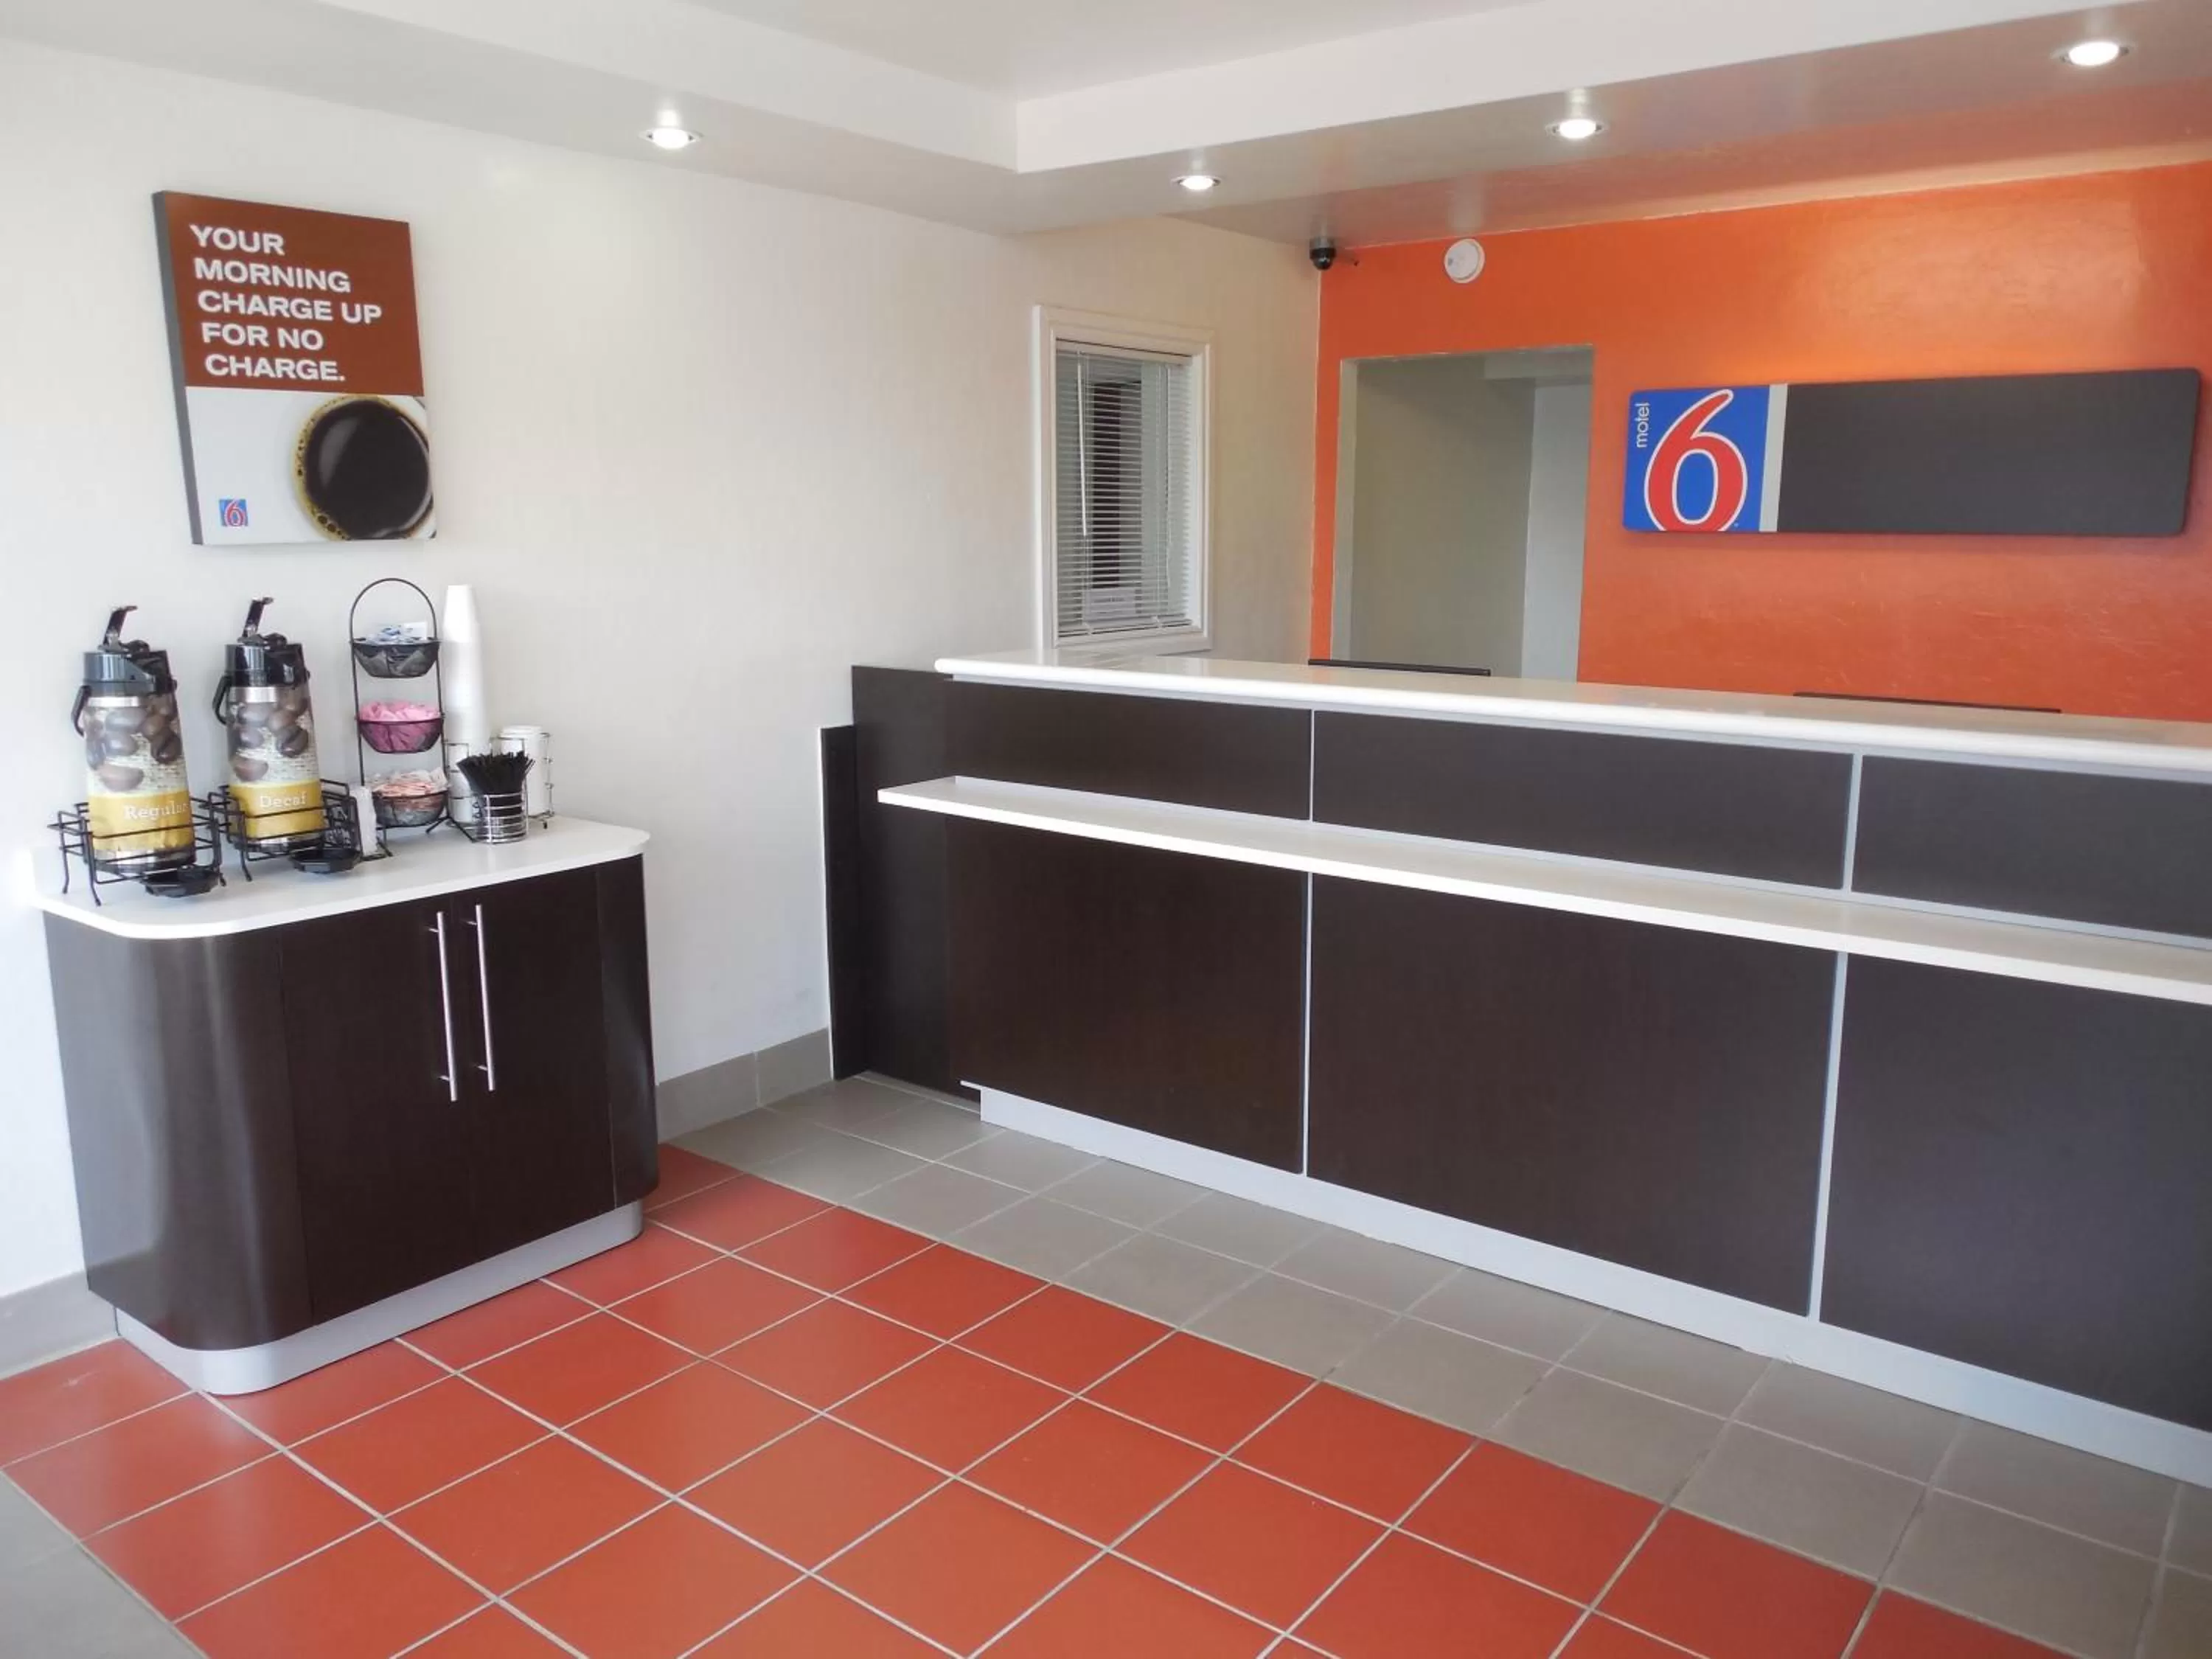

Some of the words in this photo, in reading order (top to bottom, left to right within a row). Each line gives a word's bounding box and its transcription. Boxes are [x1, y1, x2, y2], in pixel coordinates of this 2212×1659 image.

[189, 224, 285, 256] YOUR
[193, 257, 352, 293] MORNING
[198, 291, 333, 322] CHARGE
[341, 303, 382, 324] UP
[201, 322, 269, 347] FOR
[278, 329, 324, 351] NO
[204, 354, 345, 382] CHARGE.
[1635, 402, 1650, 448] motel
[1644, 389, 1748, 532] 6
[223, 499, 246, 527] 6
[260, 790, 308, 808] Decaf
